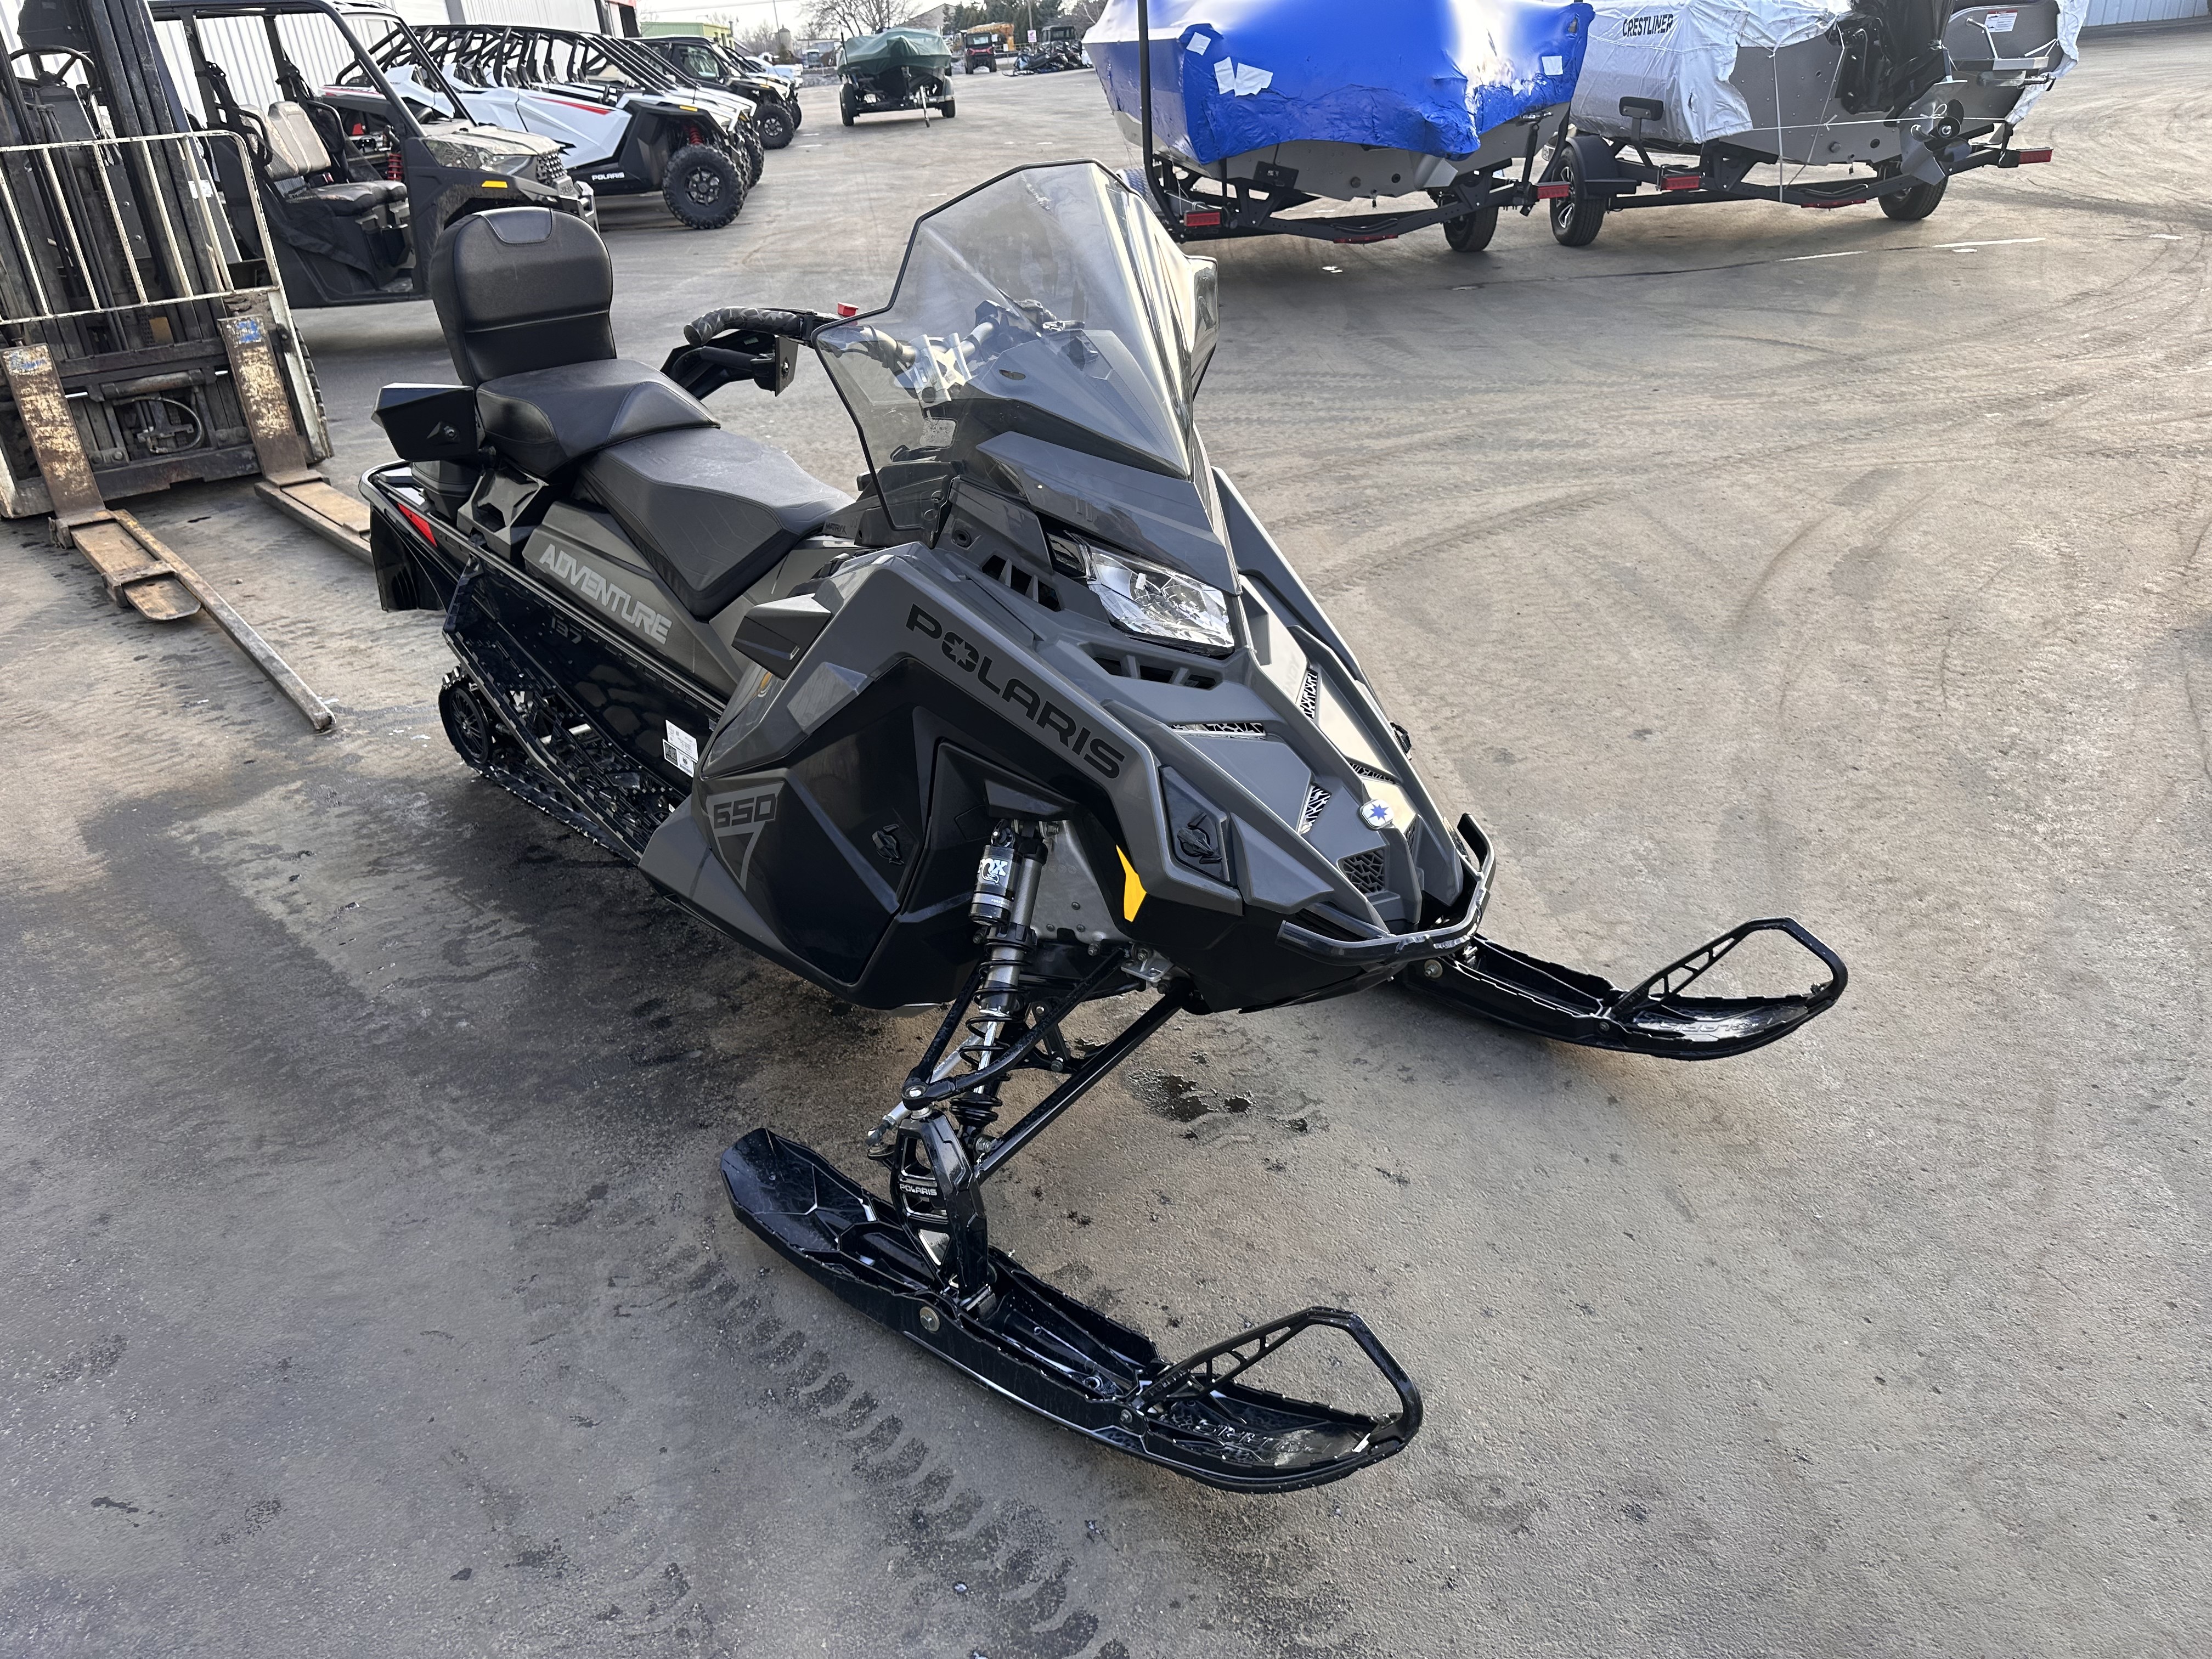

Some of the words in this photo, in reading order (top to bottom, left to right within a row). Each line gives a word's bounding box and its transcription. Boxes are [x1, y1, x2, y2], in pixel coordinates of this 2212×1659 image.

[1622, 13, 1673, 37] CRESTLINER
[591, 172, 625, 181] POLARIS
[539, 544, 672, 645] ADVENTURE
[551, 616, 582, 644] 137
[906, 603, 1125, 779] POLARIS
[713, 793, 776, 830] 650
[977, 857, 1008, 885] FOX
[899, 1183, 938, 1196] POLARIS
